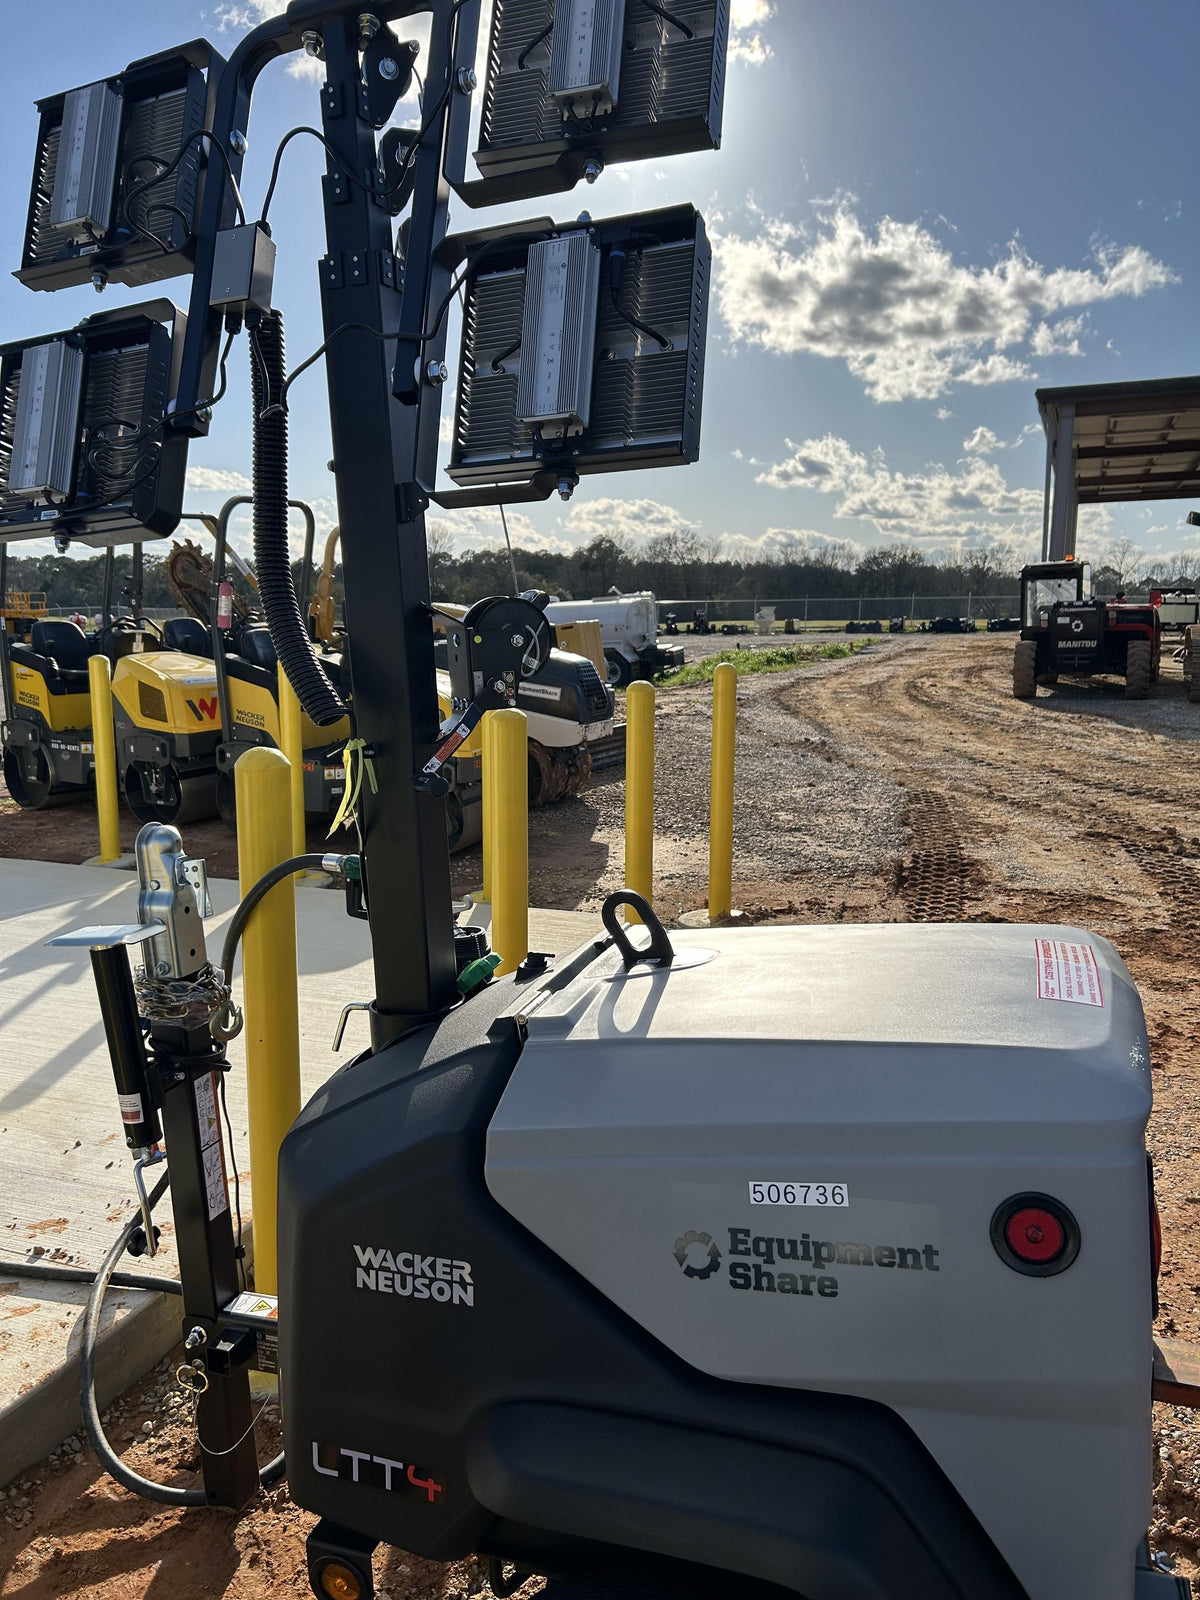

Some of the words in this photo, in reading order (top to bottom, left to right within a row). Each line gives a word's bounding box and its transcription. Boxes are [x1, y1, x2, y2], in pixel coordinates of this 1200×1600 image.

[1058, 640, 1097, 648] MANITOU
[19, 690, 39, 700] WACKER
[19, 695, 39, 707] NEUSON
[235, 715, 265, 728] NEUSON
[236, 708, 265, 721] WACKER
[752, 1184, 845, 1204] 506736
[727, 1227, 940, 1272] Equipment
[352, 1244, 474, 1283] WACKER
[356, 1266, 475, 1307] NEUSON
[729, 1263, 839, 1298] Share
[312, 1441, 442, 1502] LTT4
